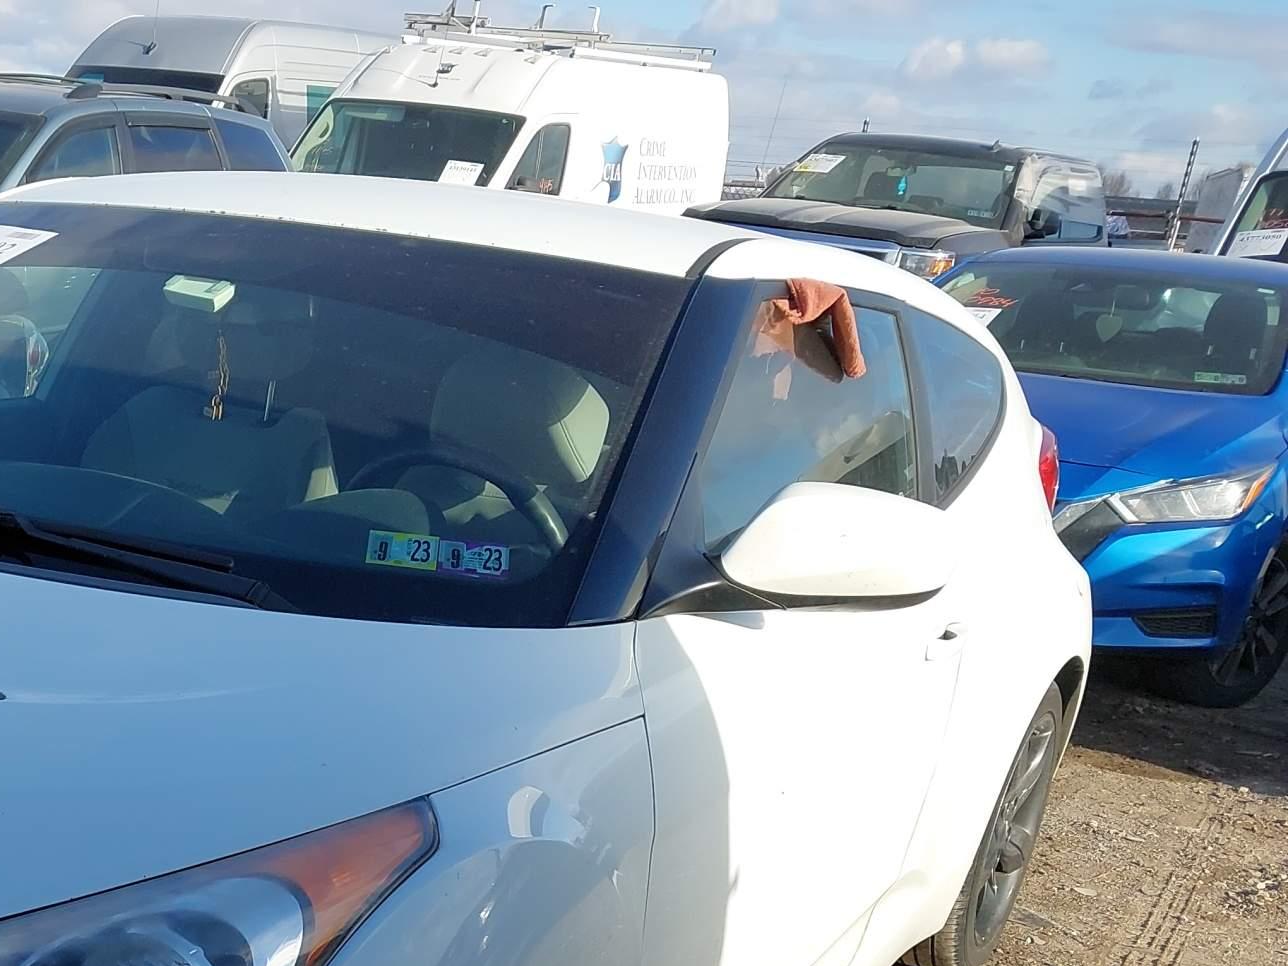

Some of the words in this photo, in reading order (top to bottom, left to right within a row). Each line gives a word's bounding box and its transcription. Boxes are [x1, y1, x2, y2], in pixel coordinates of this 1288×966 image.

[604, 163, 621, 181] CIA
[636, 162, 697, 181] INTERVENTION
[632, 186, 663, 205] ALARM
[377, 541, 389, 561] 9
[410, 539, 431, 563] 23
[450, 548, 461, 569] 9
[482, 547, 503, 572] 23
